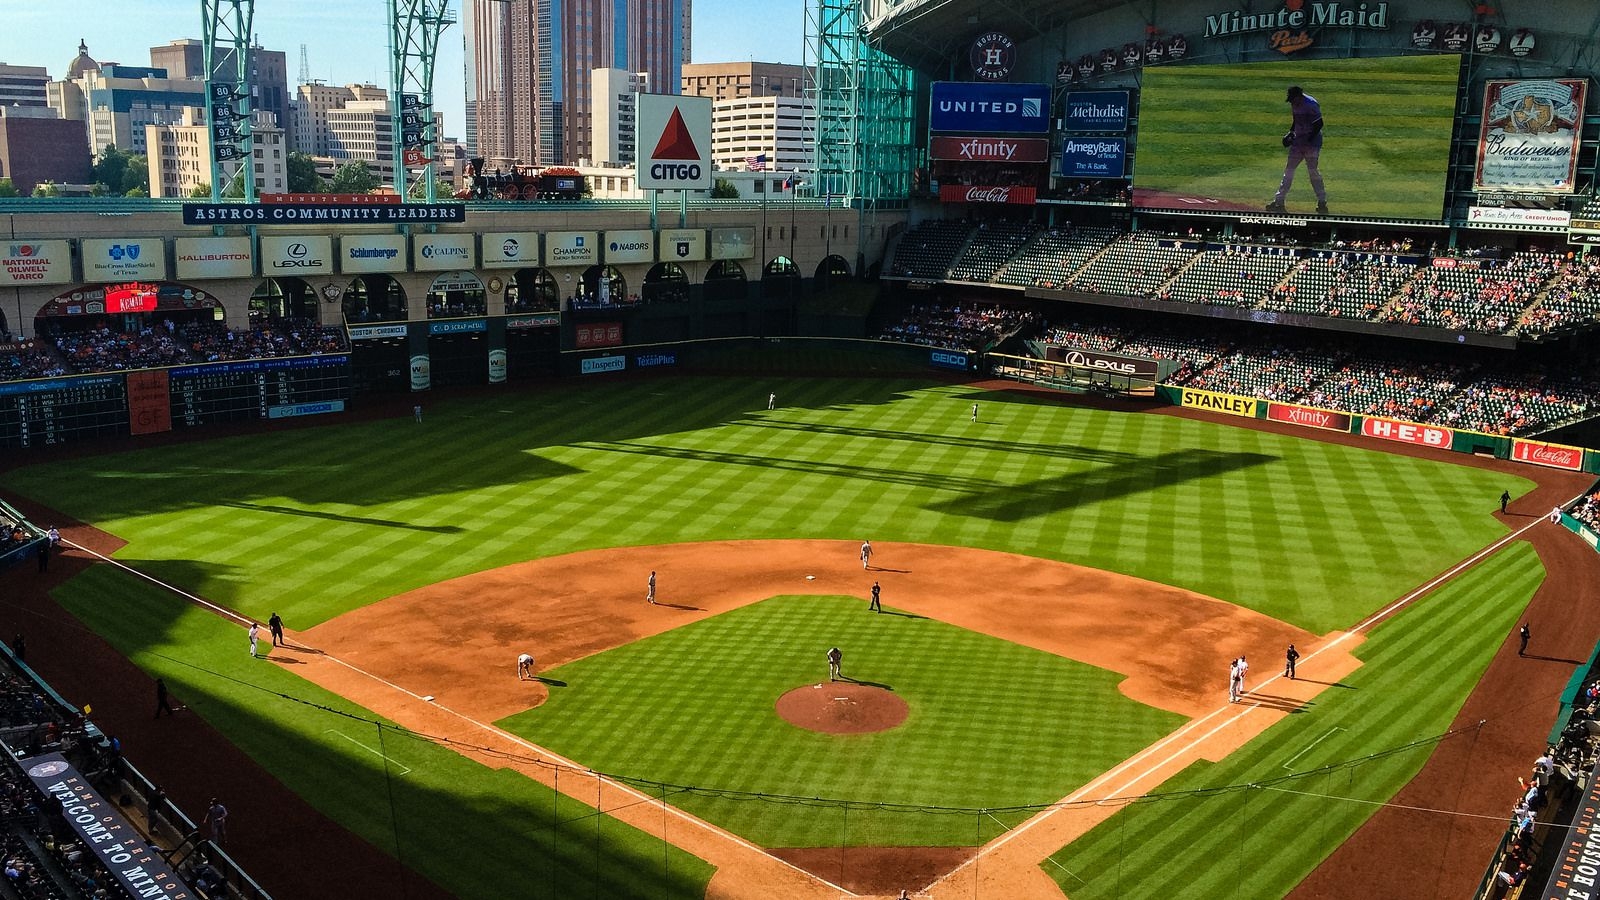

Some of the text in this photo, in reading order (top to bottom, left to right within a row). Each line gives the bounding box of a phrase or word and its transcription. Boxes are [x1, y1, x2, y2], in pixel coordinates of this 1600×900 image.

[1203, 2, 1387, 38] Minute Maid
[976, 33, 1012, 49] HOUSTON
[984, 48, 1002, 65] H
[976, 66, 1008, 78] ASTROS
[216, 87, 229, 96] 80
[405, 98, 416, 106] 99
[940, 101, 1017, 113] UNITED
[217, 108, 230, 116] 86
[1069, 104, 1125, 118] Methodist
[406, 116, 416, 124] 01
[218, 128, 230, 136] 97
[407, 134, 418, 142] 04
[960, 139, 1017, 160] xfinity
[1065, 140, 1121, 156] AmegyBank
[1486, 133, 1571, 157] Budweiser
[220, 148, 232, 156] 98
[408, 153, 418, 161] 05
[650, 164, 701, 180] CITGO
[273, 208, 382, 220] COMMUNITY
[388, 208, 457, 218] LEADERS
[1240, 217, 1307, 226] DAKTRONICS
[619, 242, 649, 251] NABORS
[350, 248, 398, 259] Schlumberger
[273, 260, 322, 268] LEXUS
[592, 360, 624, 370] Insperity
[637, 355, 675, 368] TexanPlus
[932, 352, 966, 366] GEICO
[1086, 358, 1136, 374] LEXUS
[1184, 392, 1253, 414] STANLEY
[1288, 408, 1329, 426] xfinity
[1373, 420, 1443, 445] H-E-B
[47, 781, 114, 844] WELCOME
[102, 843, 132, 864] TO
[67, 777, 100, 809] HOME
[103, 816, 121, 831] OF
[124, 839, 152, 864] THE
[1555, 841, 1583, 889] MINUTE
[1576, 807, 1595, 835] MAID
